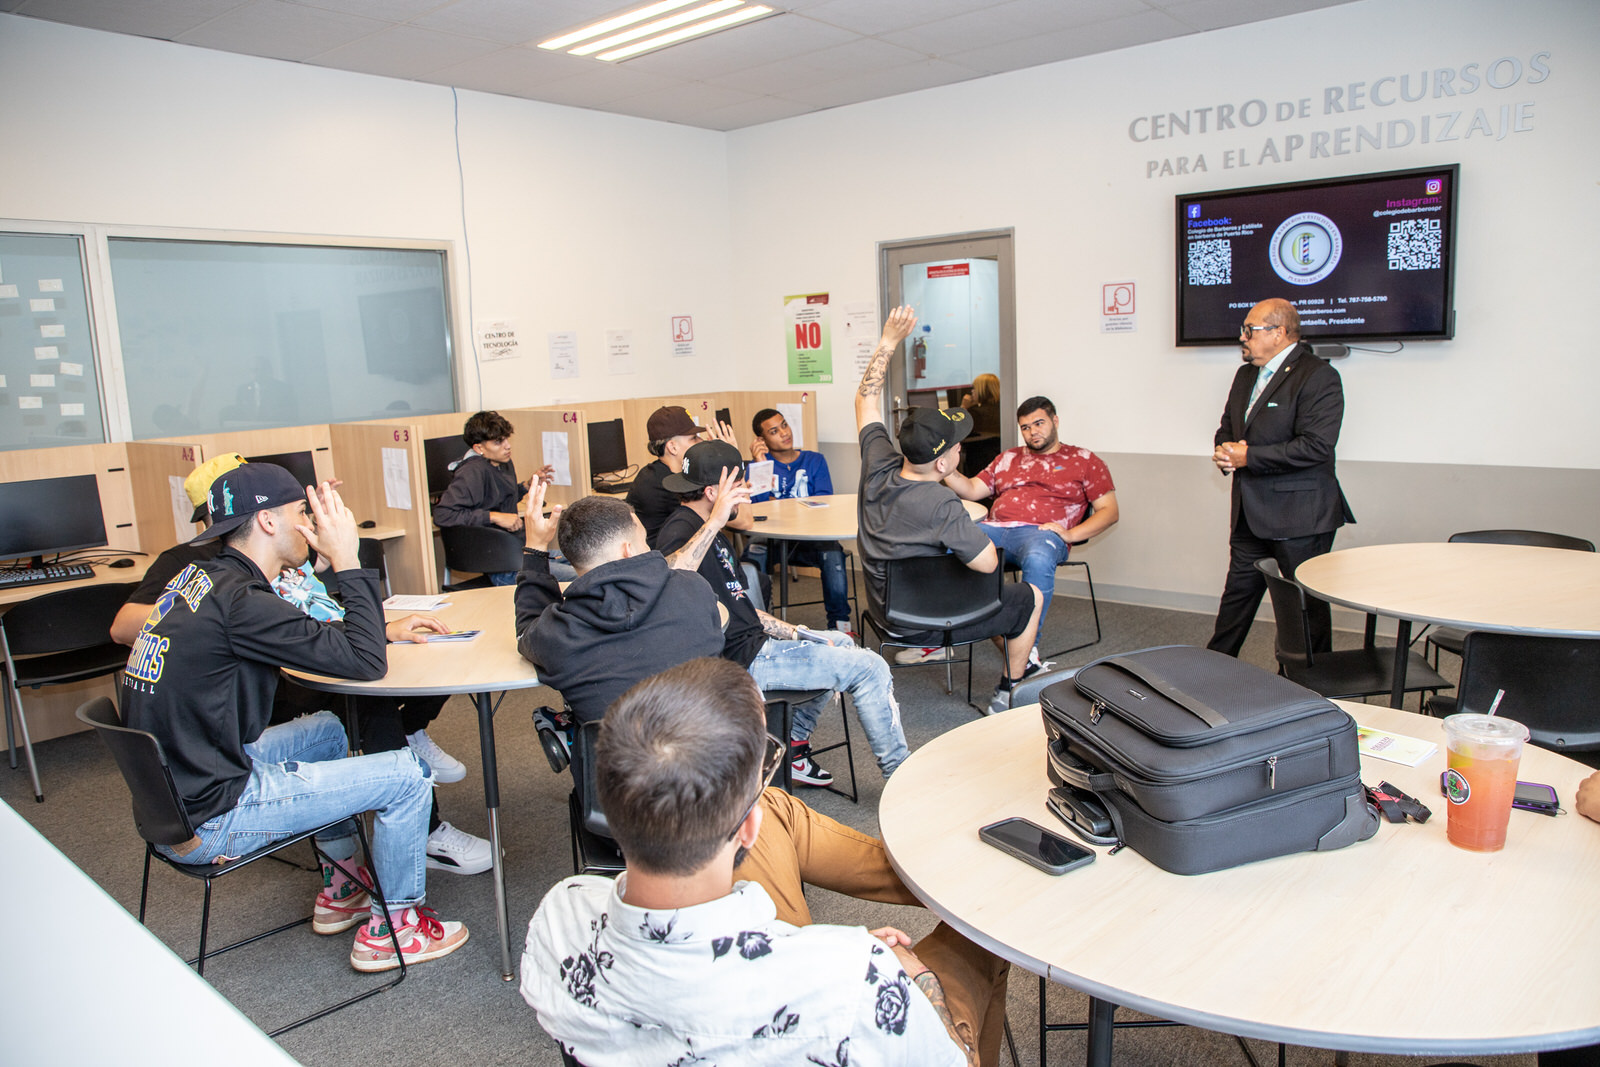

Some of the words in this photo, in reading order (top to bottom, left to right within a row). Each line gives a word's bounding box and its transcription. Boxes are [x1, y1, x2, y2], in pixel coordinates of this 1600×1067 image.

[1129, 98, 1268, 143] CENTRO
[1275, 98, 1311, 122] DE
[1323, 51, 1551, 115] RECURSOS
[1146, 153, 1208, 179] PARA
[1223, 148, 1250, 169] EL
[1257, 101, 1536, 166] APRENDIZAJE
[1386, 196, 1442, 208] Instagram:
[1187, 216, 1232, 228] Facebook:
[795, 322, 822, 349] NO
